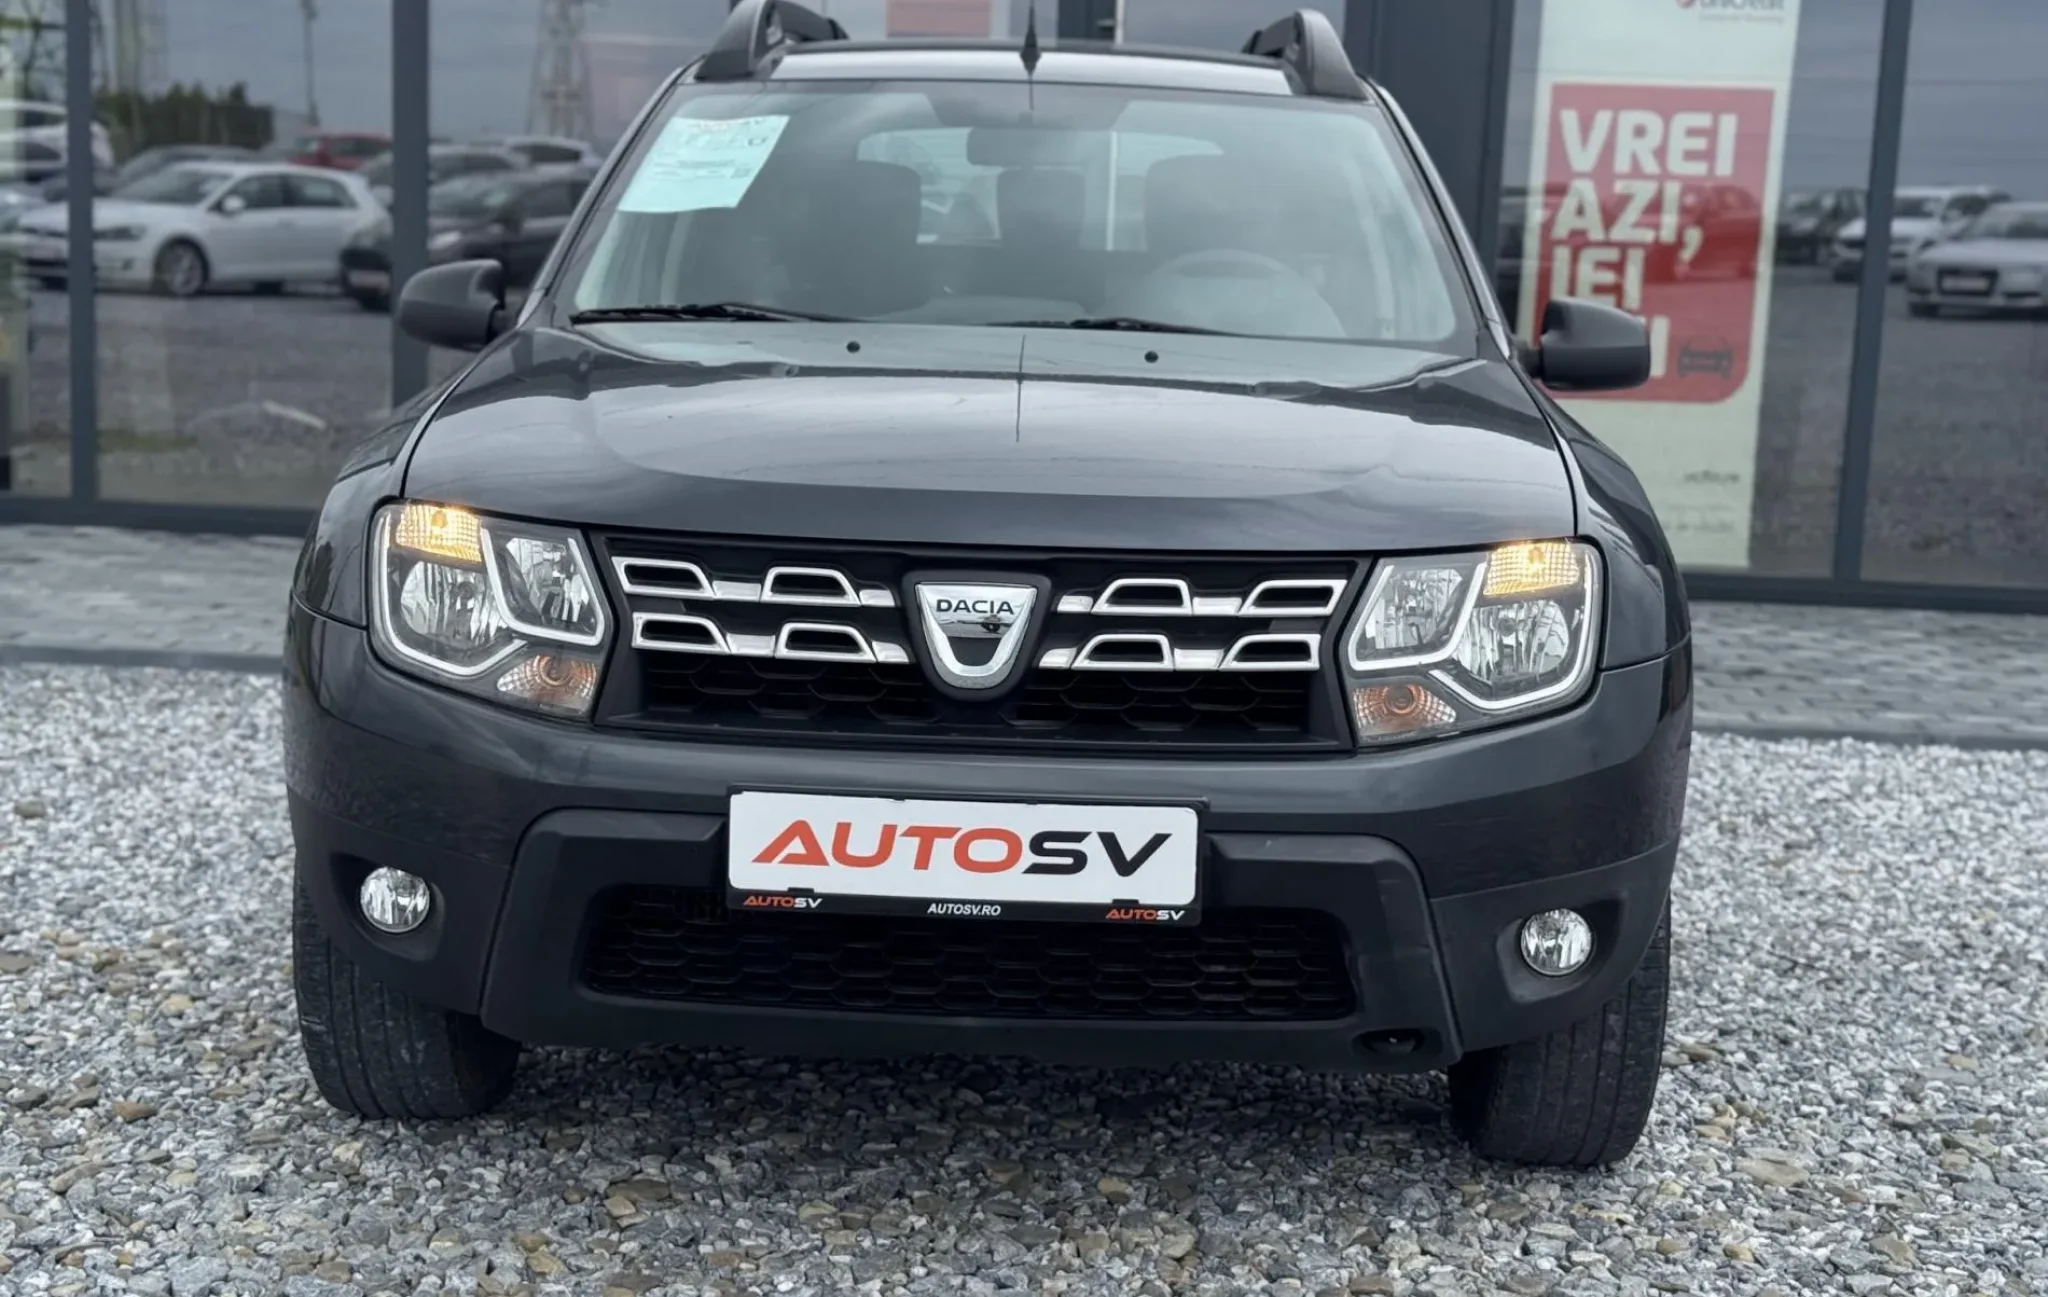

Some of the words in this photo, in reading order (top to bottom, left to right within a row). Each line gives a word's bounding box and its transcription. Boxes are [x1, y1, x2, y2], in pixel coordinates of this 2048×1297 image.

[1560, 107, 1738, 178] VREI
[1551, 177, 1704, 264] AZI,
[936, 599, 1014, 615] DACIA
[752, 819, 1172, 878] AUTOSV
[743, 895, 823, 909] AUTOSV
[927, 902, 1001, 916] AUTOSV.RO
[1105, 908, 1186, 921] AUTOSV
